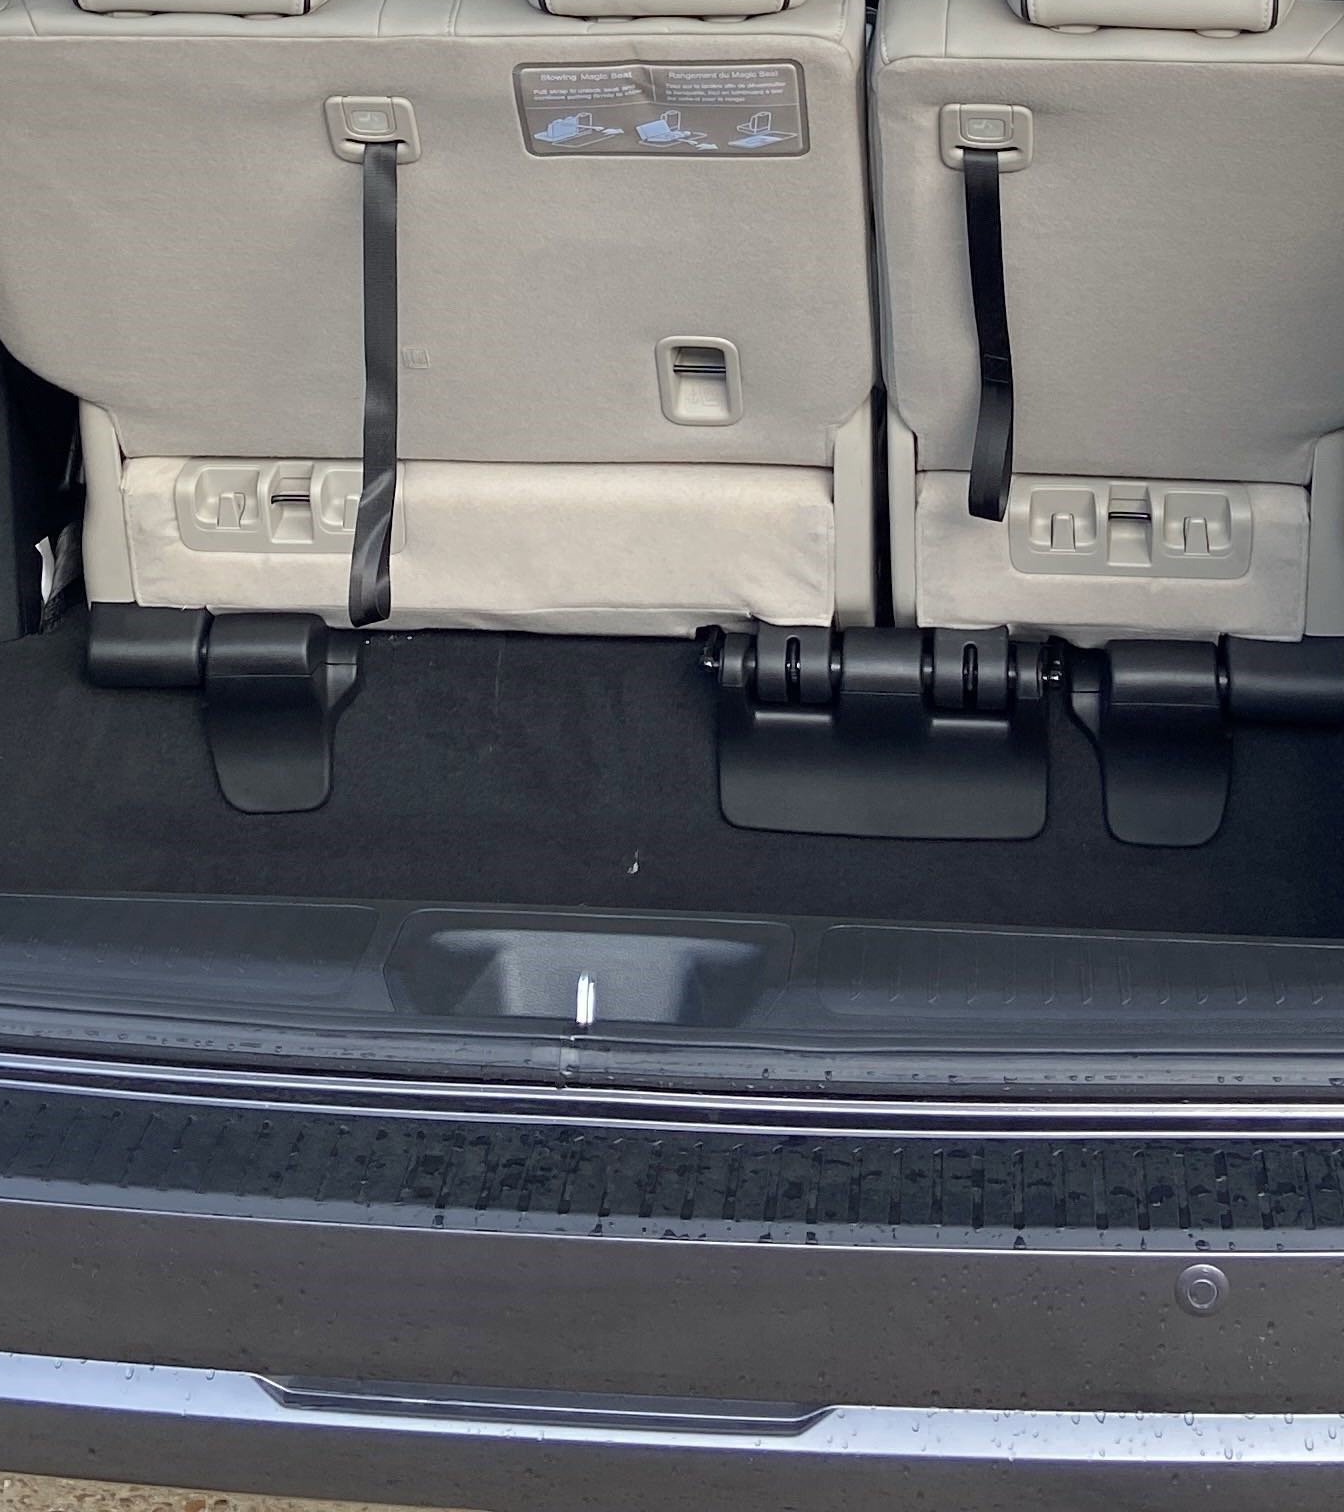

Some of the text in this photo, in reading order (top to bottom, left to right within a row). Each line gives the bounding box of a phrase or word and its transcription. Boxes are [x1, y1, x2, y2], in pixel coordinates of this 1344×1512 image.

[580, 72, 609, 81] Magic
[611, 71, 632, 79] Seat
[668, 71, 717, 81] Rangement
[719, 71, 730, 79] du
[731, 71, 757, 80] Magic
